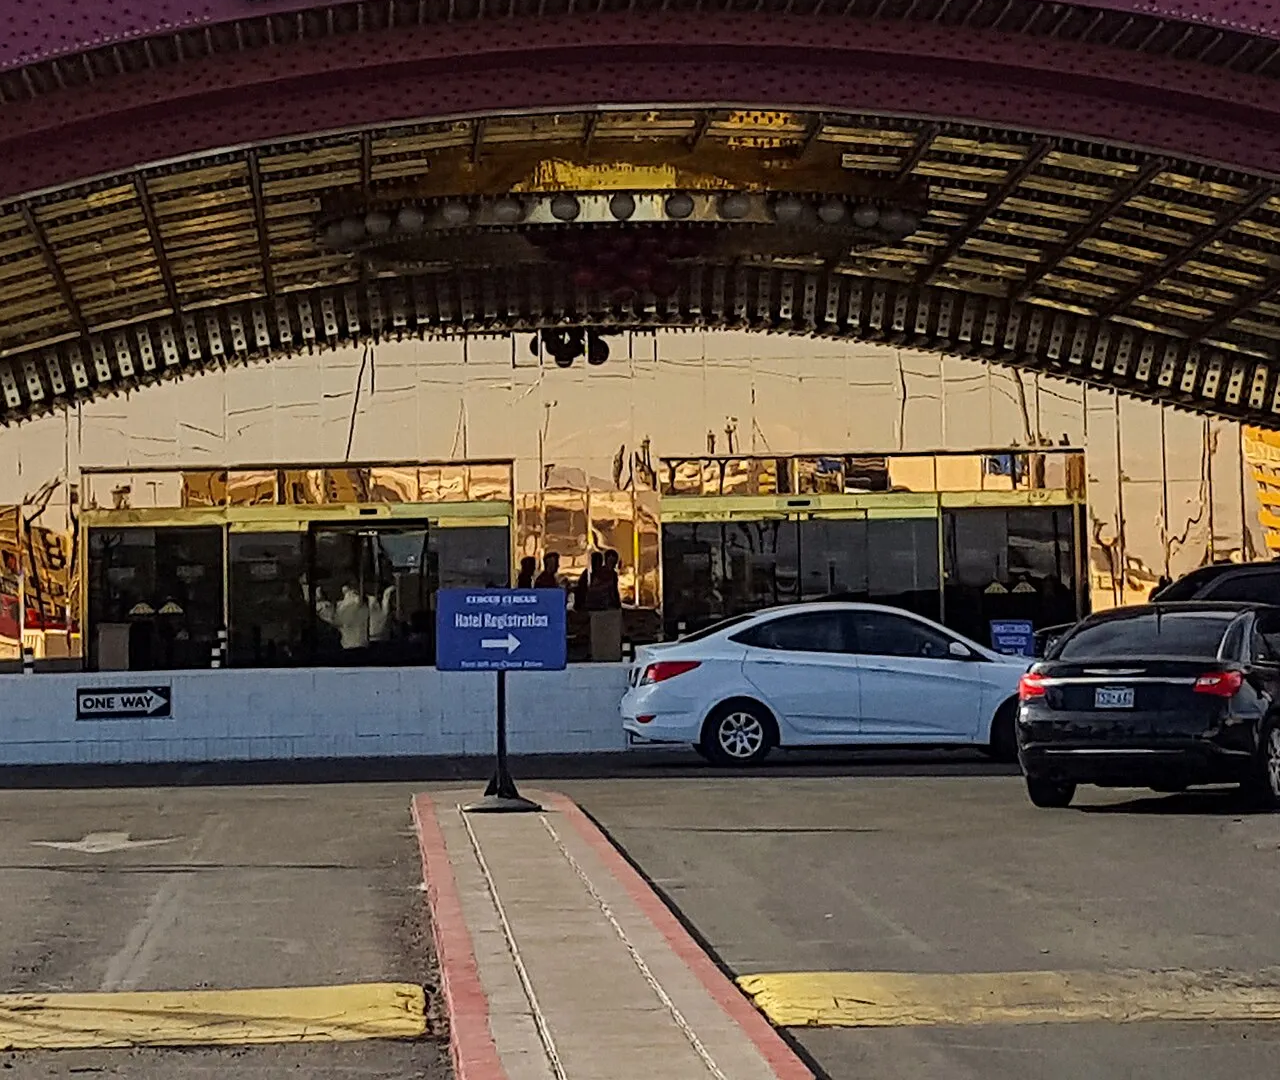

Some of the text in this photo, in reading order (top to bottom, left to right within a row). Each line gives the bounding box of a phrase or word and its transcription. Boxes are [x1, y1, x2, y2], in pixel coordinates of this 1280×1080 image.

[455, 612, 549, 630] Hotel Registration
[82, 695, 154, 710] ONE WAY
